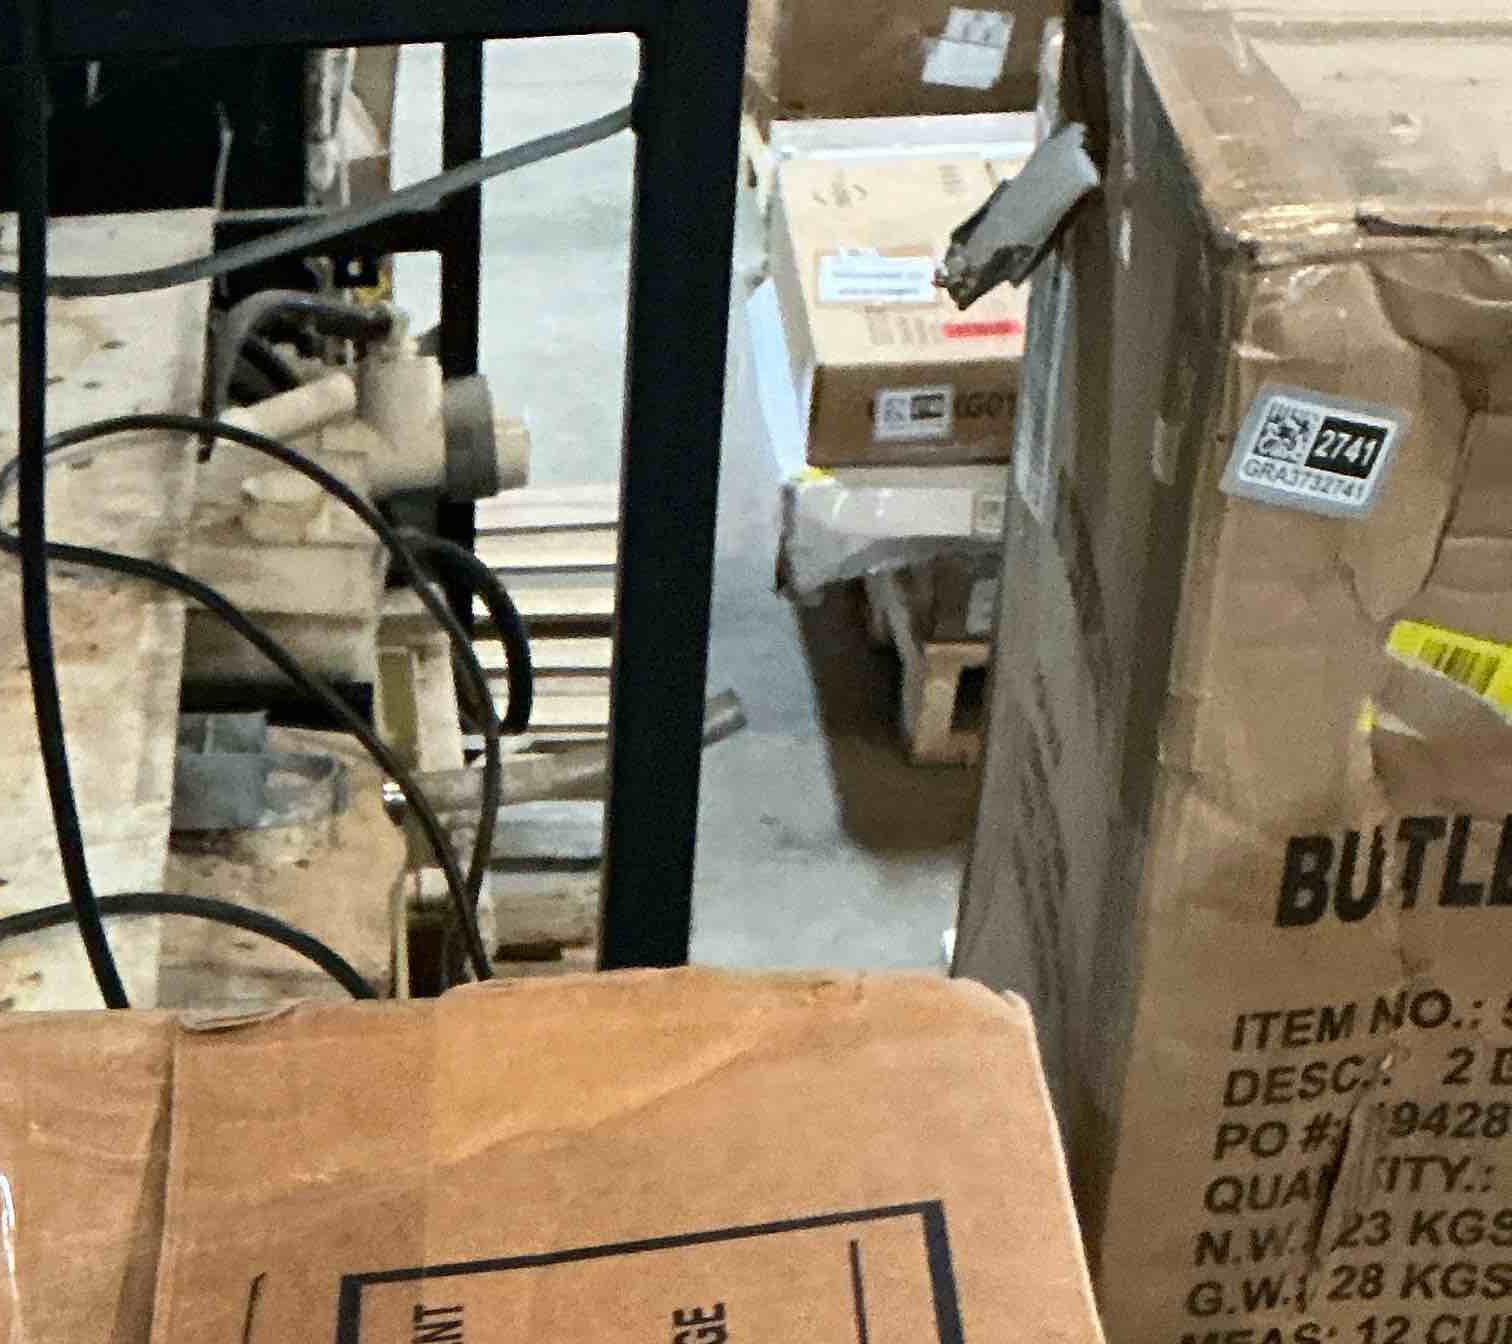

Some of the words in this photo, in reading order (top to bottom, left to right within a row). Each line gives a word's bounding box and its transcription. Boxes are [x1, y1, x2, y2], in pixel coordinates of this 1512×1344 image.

[1313, 428, 1378, 467] 2741
[1241, 458, 1365, 501] GRA3732741
[1232, 1003, 1357, 1051] ITEM
[1368, 988, 1483, 1034] NO.:
[1441, 1046, 1475, 1085] 2
[1213, 1119, 1289, 1160] PO
[1332, 1208, 1392, 1252] 23
[1407, 1207, 1512, 1247] KGS
[1326, 1262, 1385, 1300] 28
[1399, 1261, 1512, 1300] KGS
